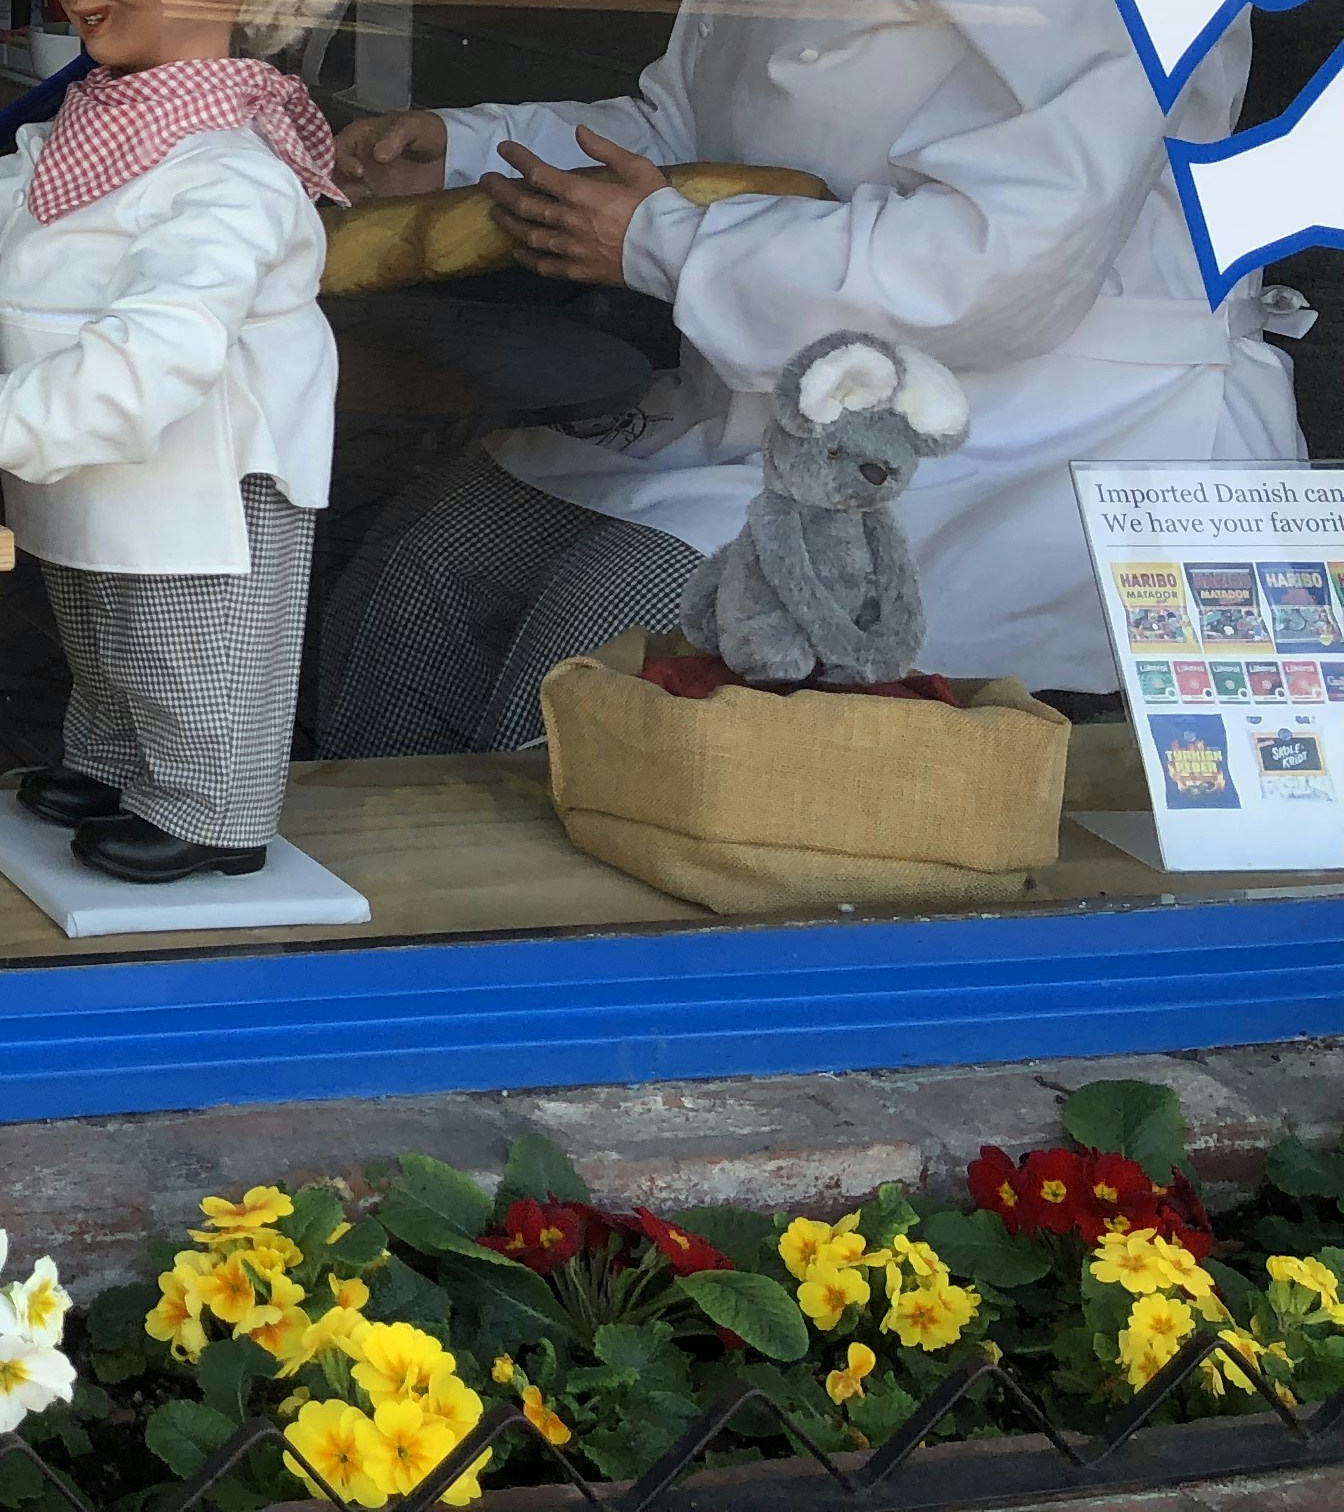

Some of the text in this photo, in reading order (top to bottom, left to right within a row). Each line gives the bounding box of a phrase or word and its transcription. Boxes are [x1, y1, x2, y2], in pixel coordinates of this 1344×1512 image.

[1094, 481, 1209, 508] Imported
[1213, 481, 1299, 504] Danish
[1101, 511, 1344, 538] We have your favorit
[1119, 572, 1179, 589] HARIBO
[1265, 571, 1323, 589] HARIBO
[1126, 590, 1178, 599] MATADOR
[1200, 589, 1250, 599] MATADOR
